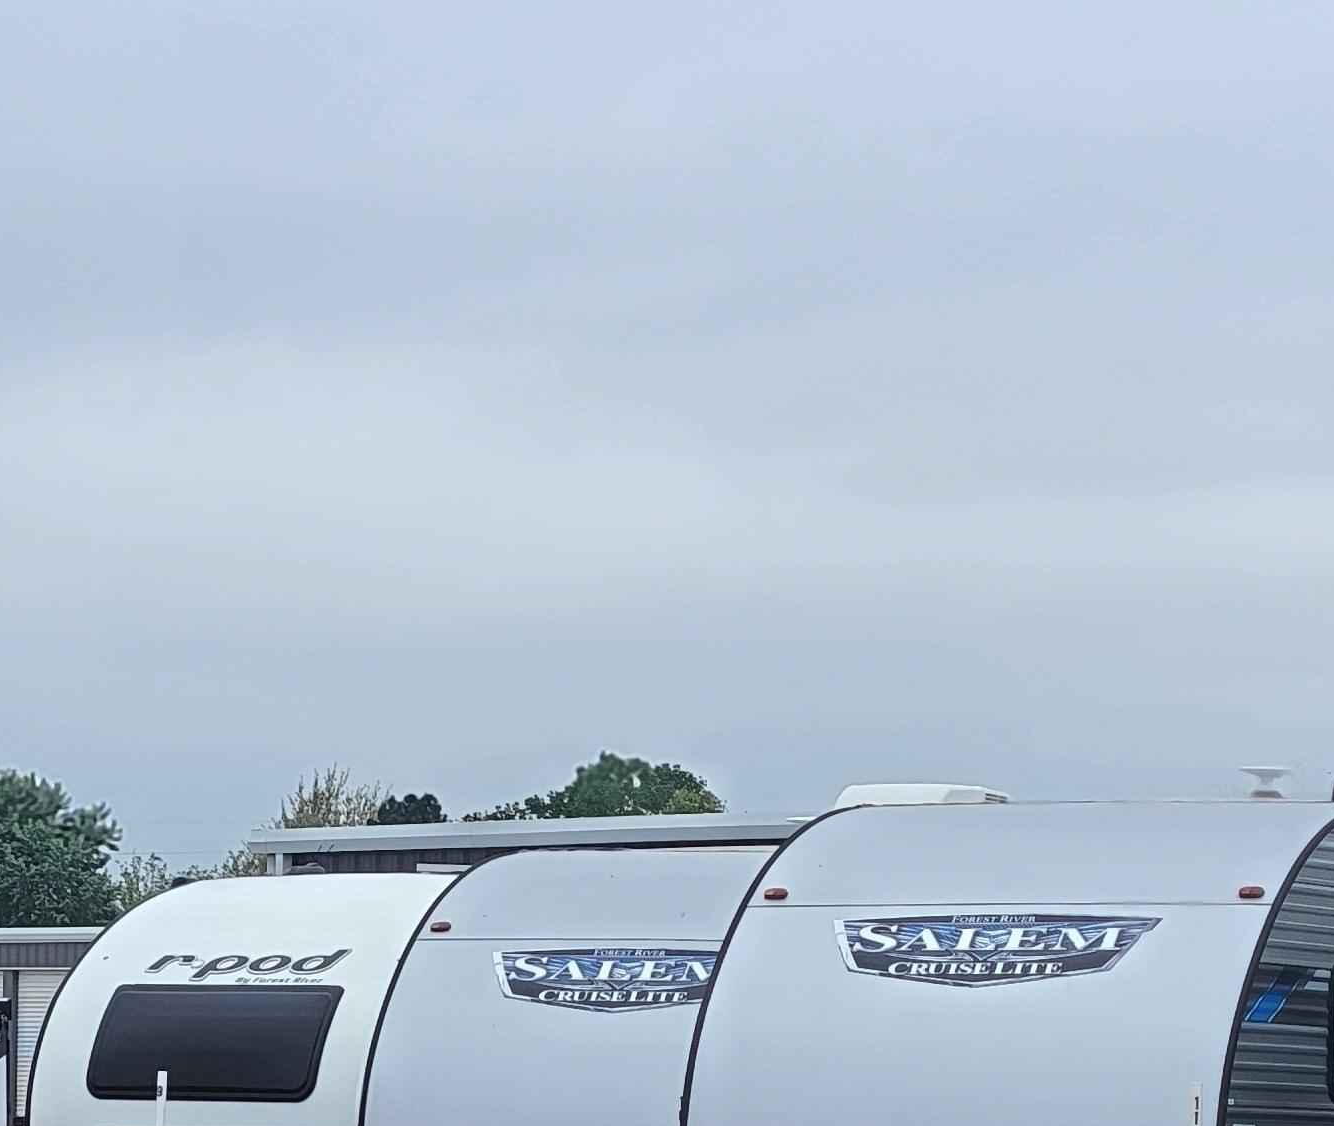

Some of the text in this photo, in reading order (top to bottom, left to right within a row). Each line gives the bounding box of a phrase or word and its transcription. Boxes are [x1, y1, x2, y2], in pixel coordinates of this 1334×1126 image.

[951, 914, 1036, 923] FOREST RIVER
[853, 924, 1125, 951] SALEM
[593, 948, 667, 957] FOREST RIVER
